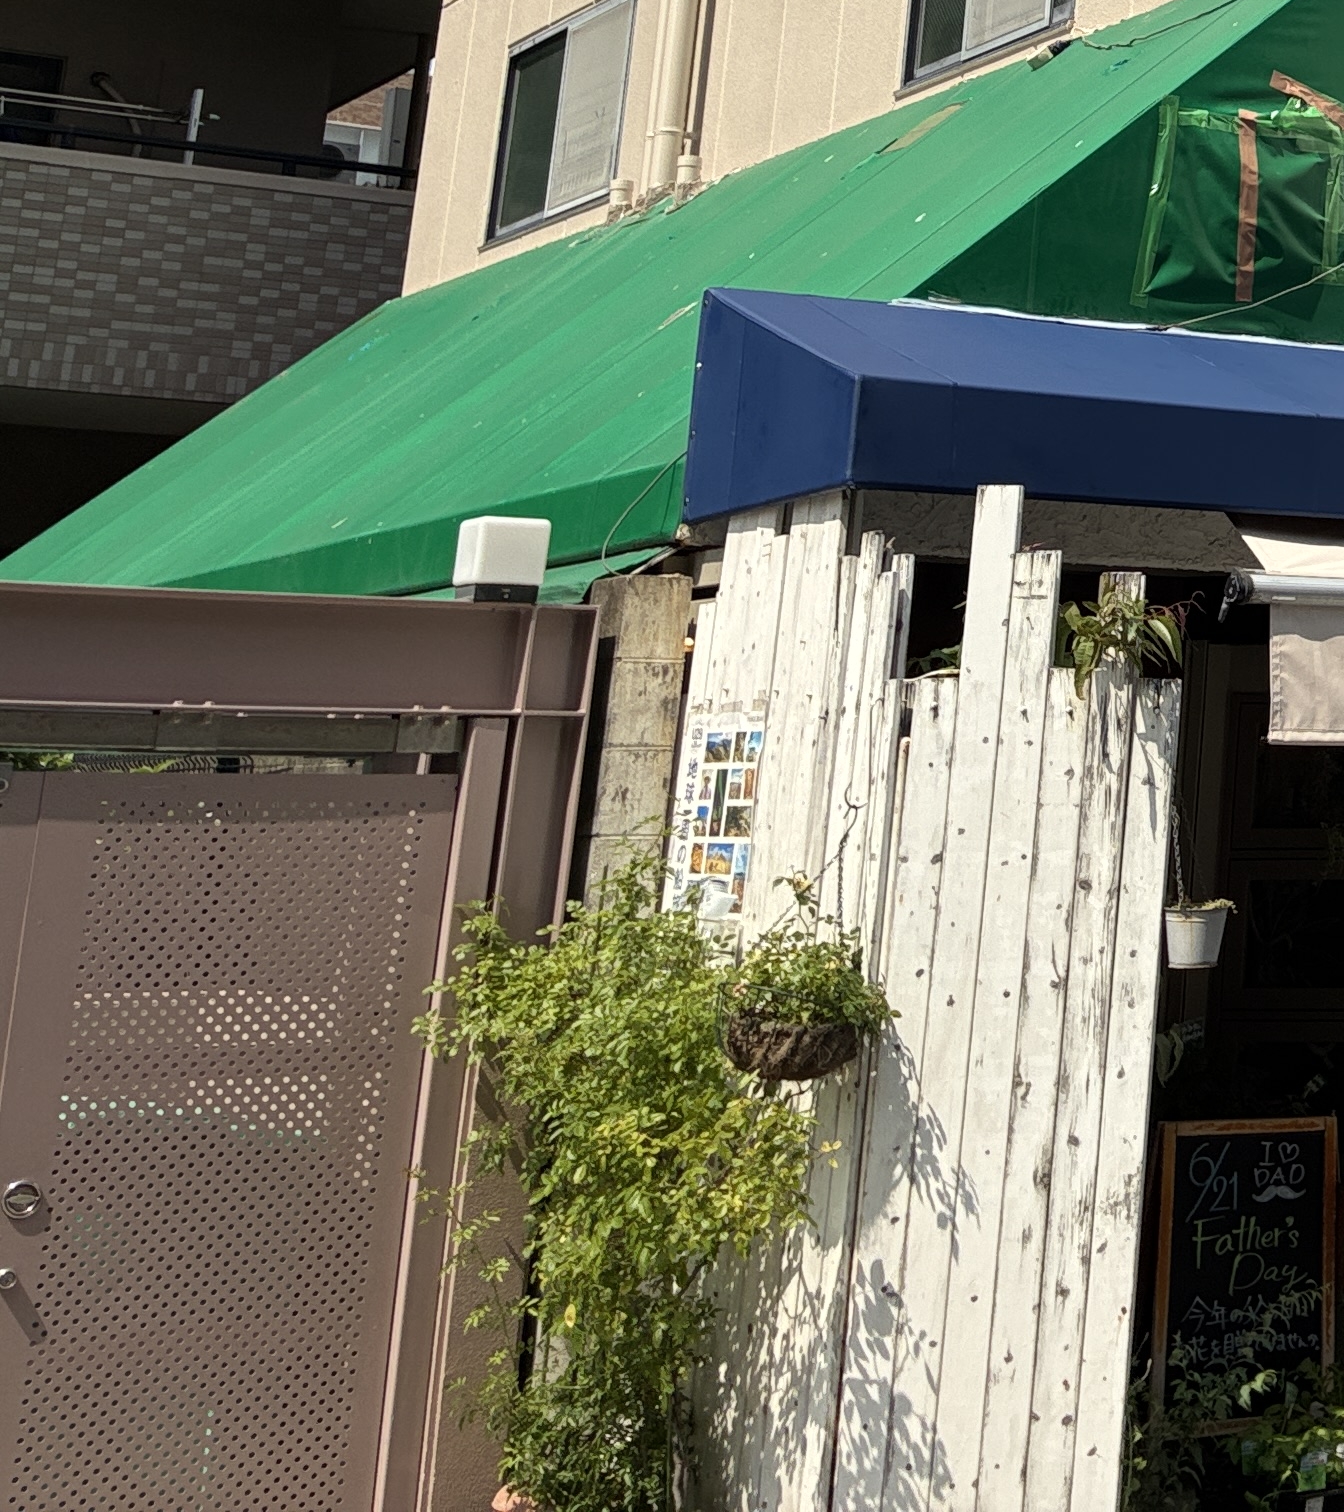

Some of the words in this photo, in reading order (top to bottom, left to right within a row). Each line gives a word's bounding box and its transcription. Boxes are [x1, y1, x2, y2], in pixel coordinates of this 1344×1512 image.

[1186, 1141, 1238, 1223] 6/21
[1254, 1164, 1305, 1187] DAD
[1192, 1215, 1299, 1269] Father's
[1229, 1252, 1308, 1296] Day
